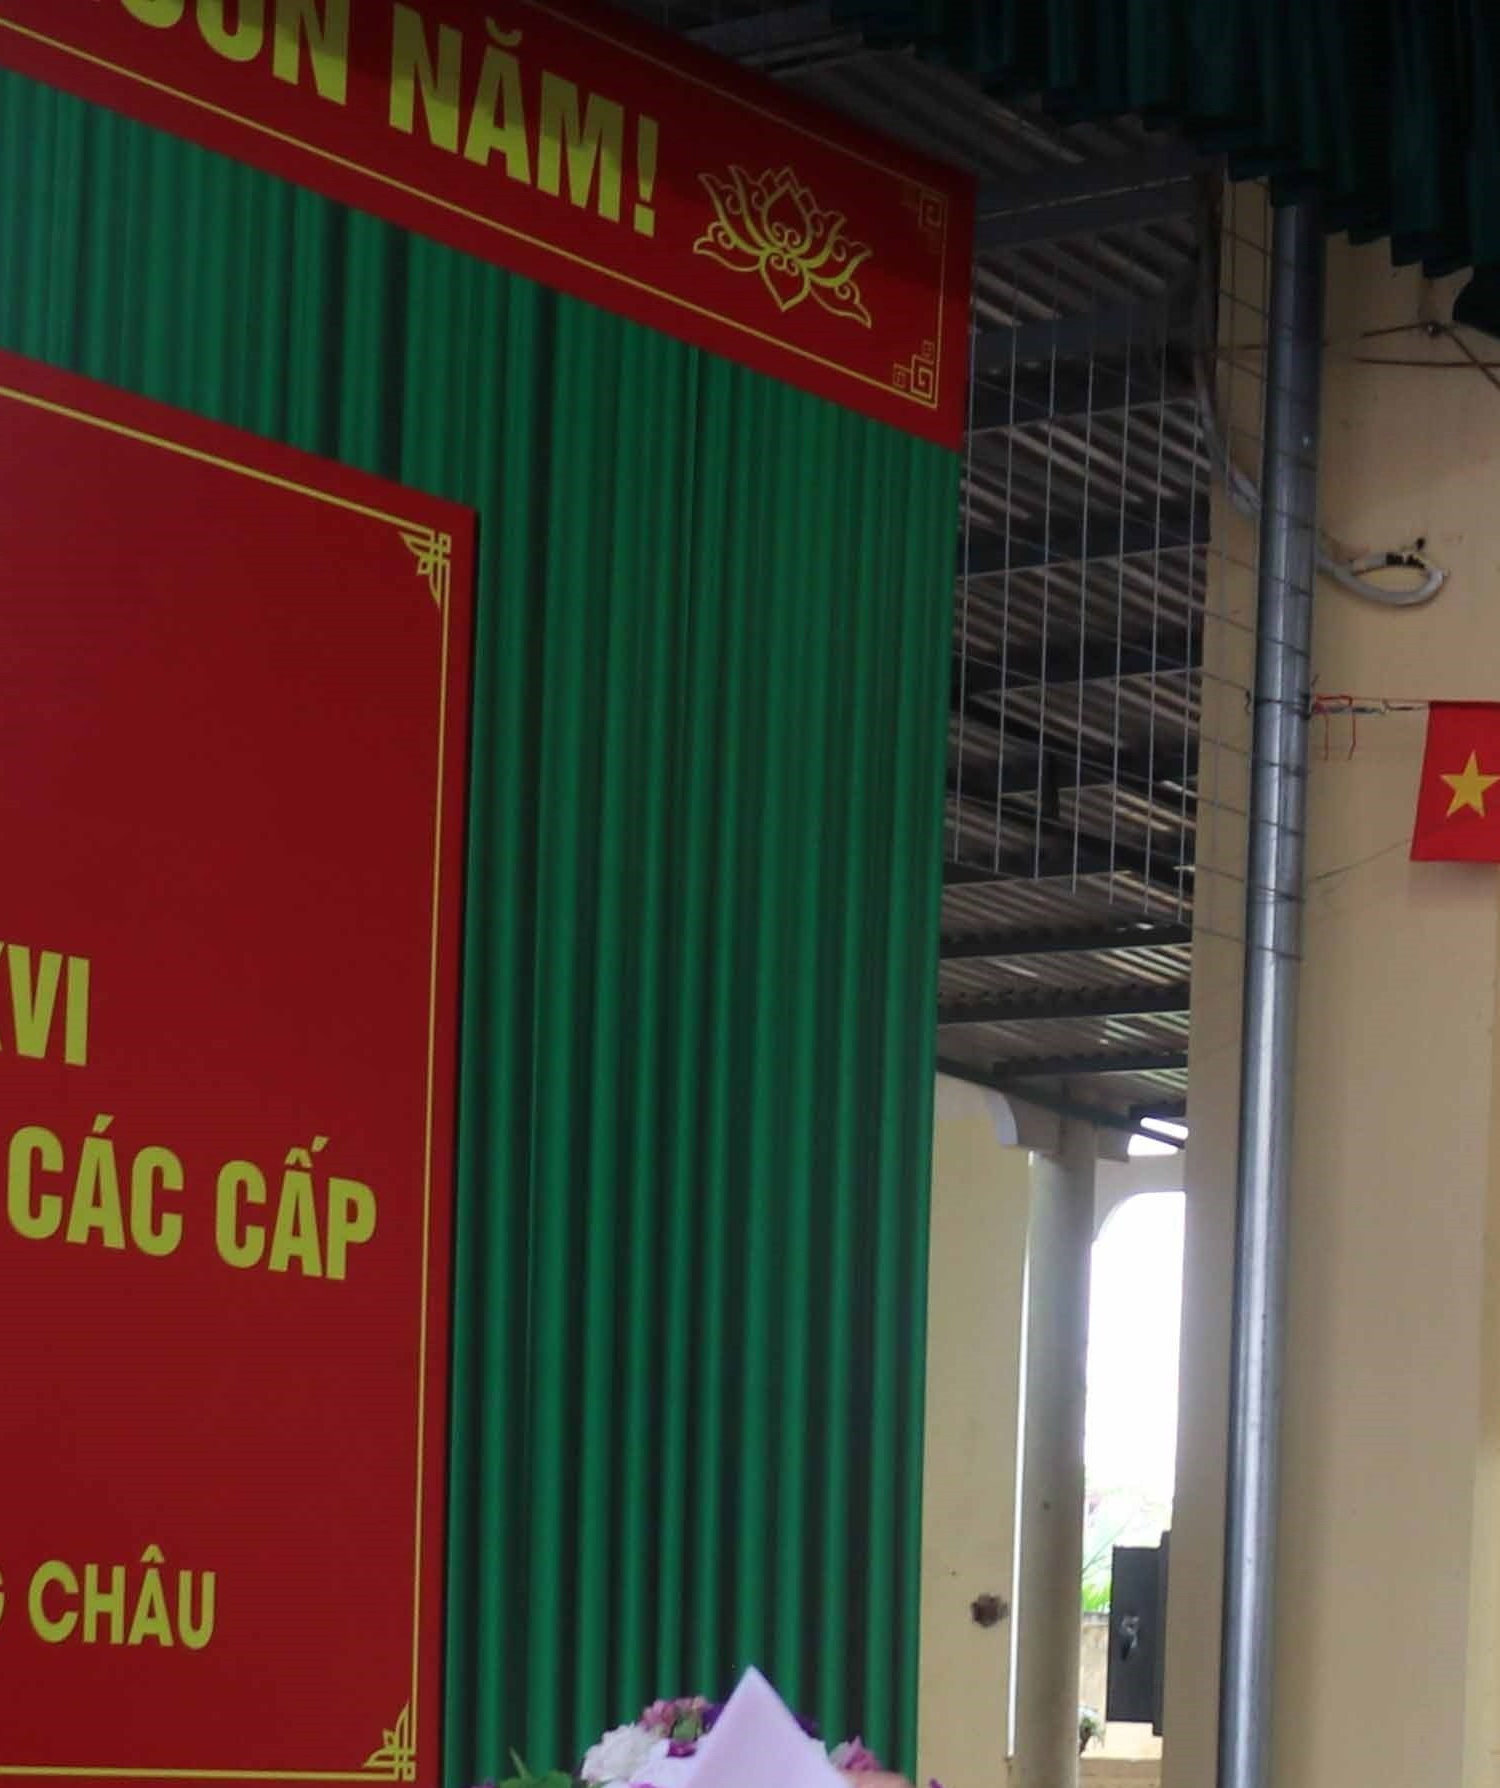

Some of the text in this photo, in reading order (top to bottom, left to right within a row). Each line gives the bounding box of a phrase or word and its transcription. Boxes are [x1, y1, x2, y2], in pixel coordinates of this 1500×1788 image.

[389, 4, 659, 238] NĂM!
[9, 1115, 182, 1254] CÁC
[217, 1138, 375, 1279] CẤP
[29, 1546, 214, 1650] CHÂU
